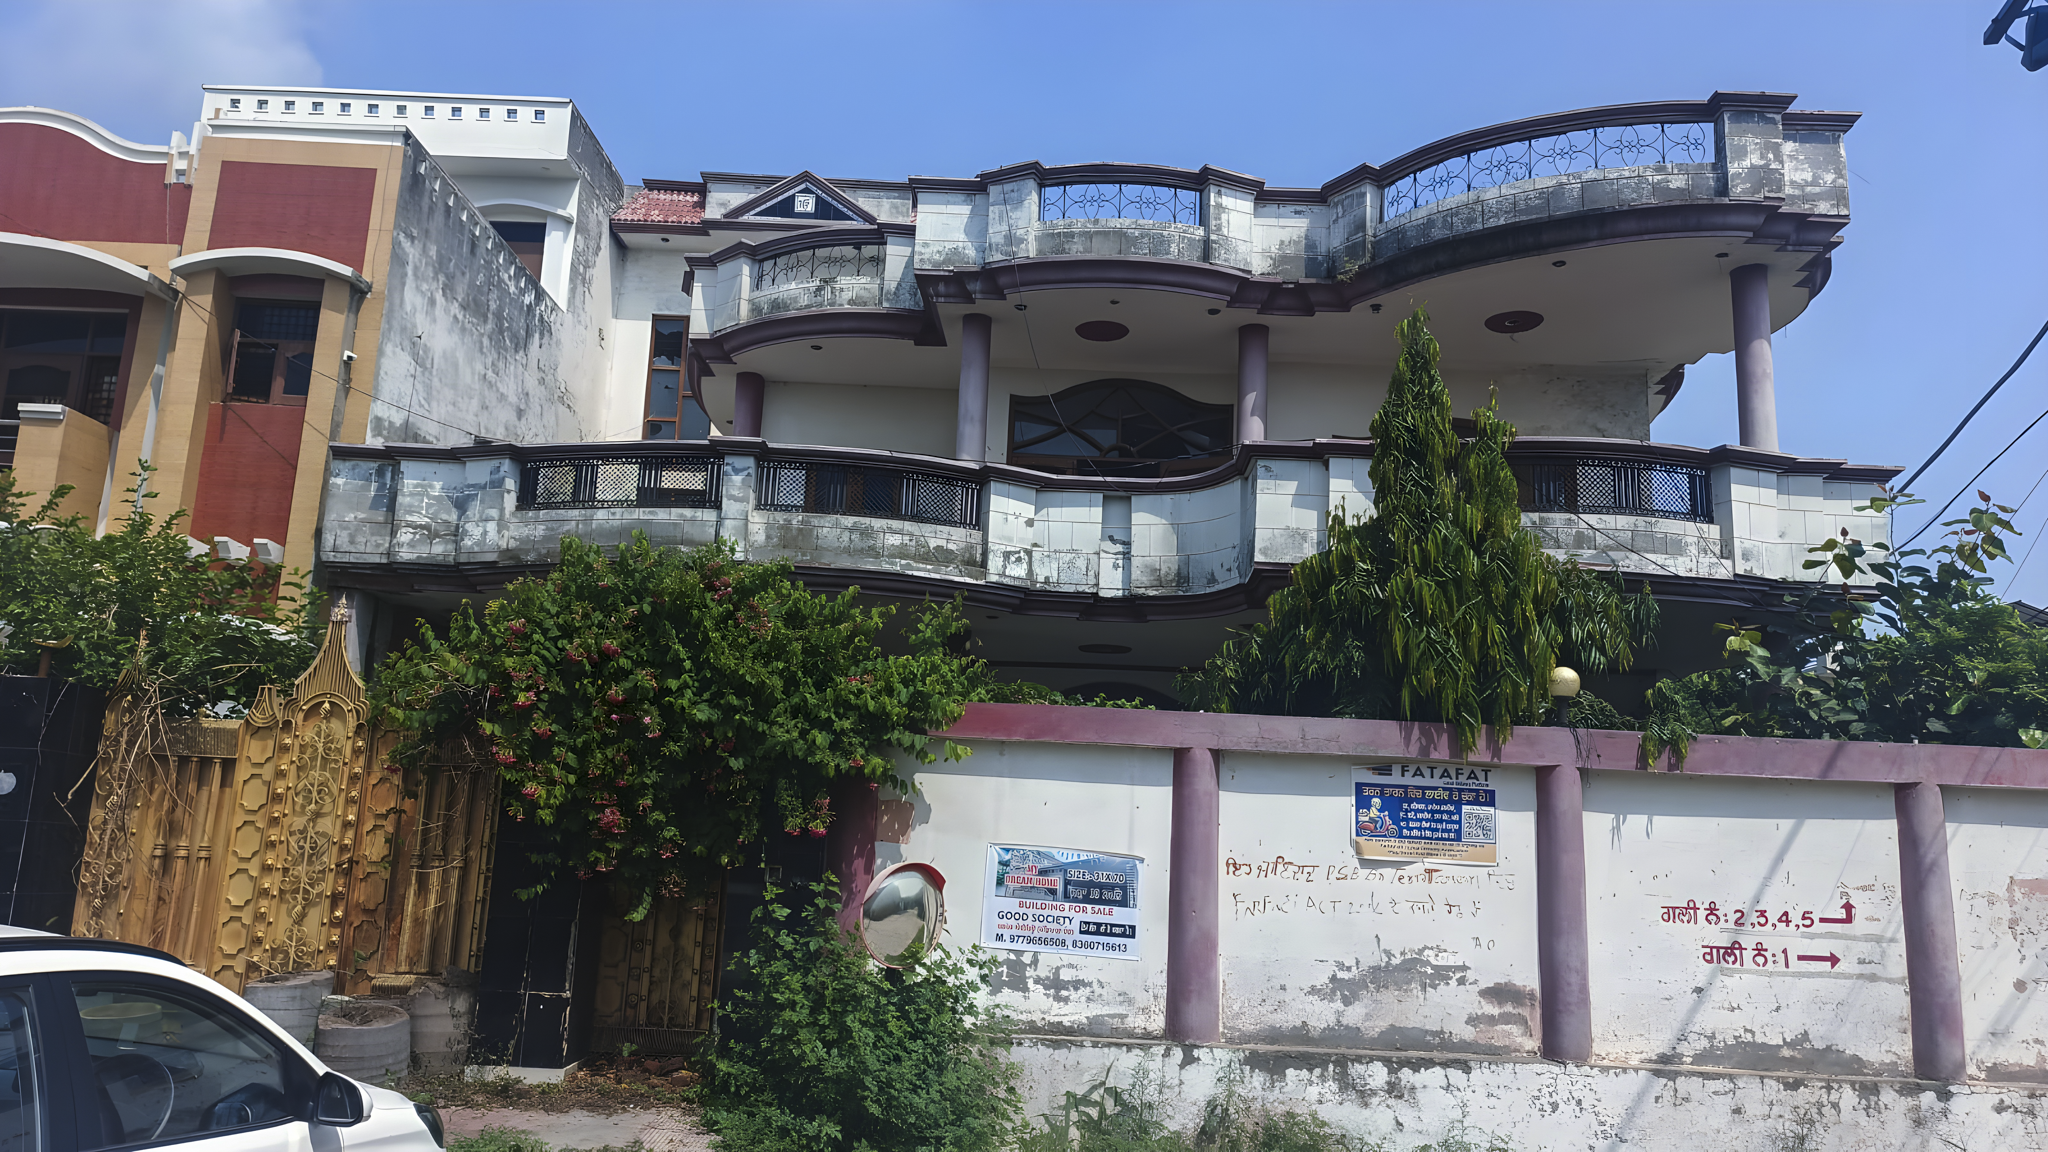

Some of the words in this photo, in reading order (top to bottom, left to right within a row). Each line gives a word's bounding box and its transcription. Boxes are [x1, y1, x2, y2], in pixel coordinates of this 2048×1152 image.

[1400, 765, 1492, 782] FATAFAT
[1018, 900, 1066, 912] BUILDING
[1068, 905, 1088, 914] FOR
[1091, 906, 1114, 916] SALE
[1660, 899, 1700, 925] ਗਲੀ
[997, 910, 1029, 921] GOOD
[1031, 913, 1075, 926] SOCIETY
[1701, 941, 1747, 967] ਗਲੀ
